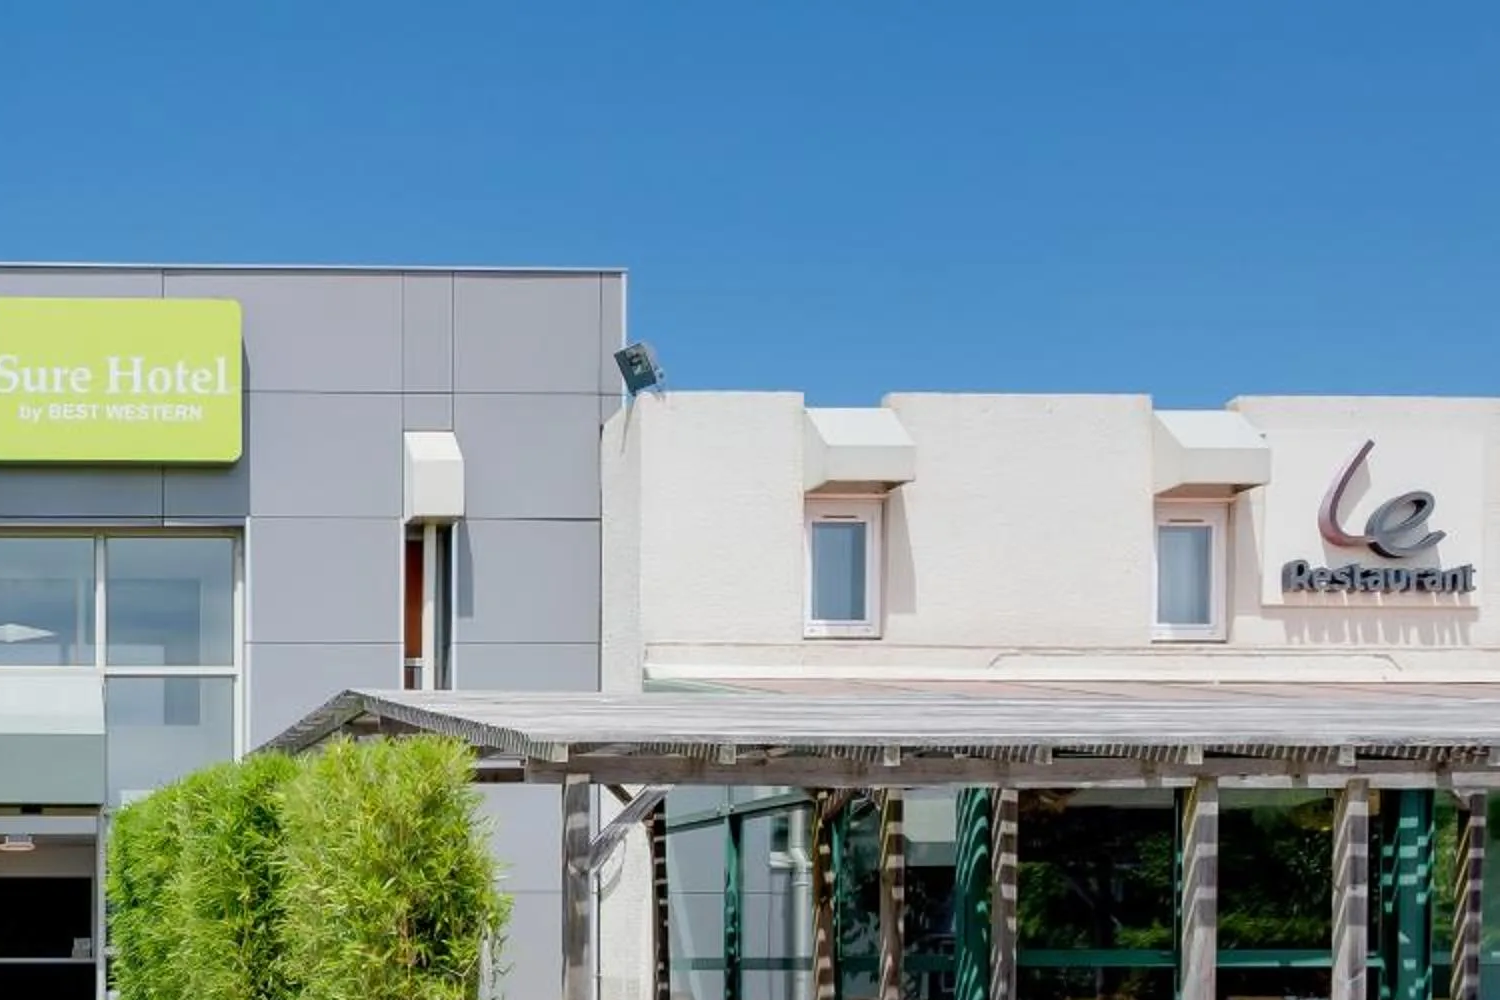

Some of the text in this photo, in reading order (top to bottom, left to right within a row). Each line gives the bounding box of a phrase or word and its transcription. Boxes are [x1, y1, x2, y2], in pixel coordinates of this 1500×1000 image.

[106, 355, 230, 395] Hotel
[18, 403, 203, 422] by BEST WESTERN
[1281, 559, 1476, 593] Restaurant
